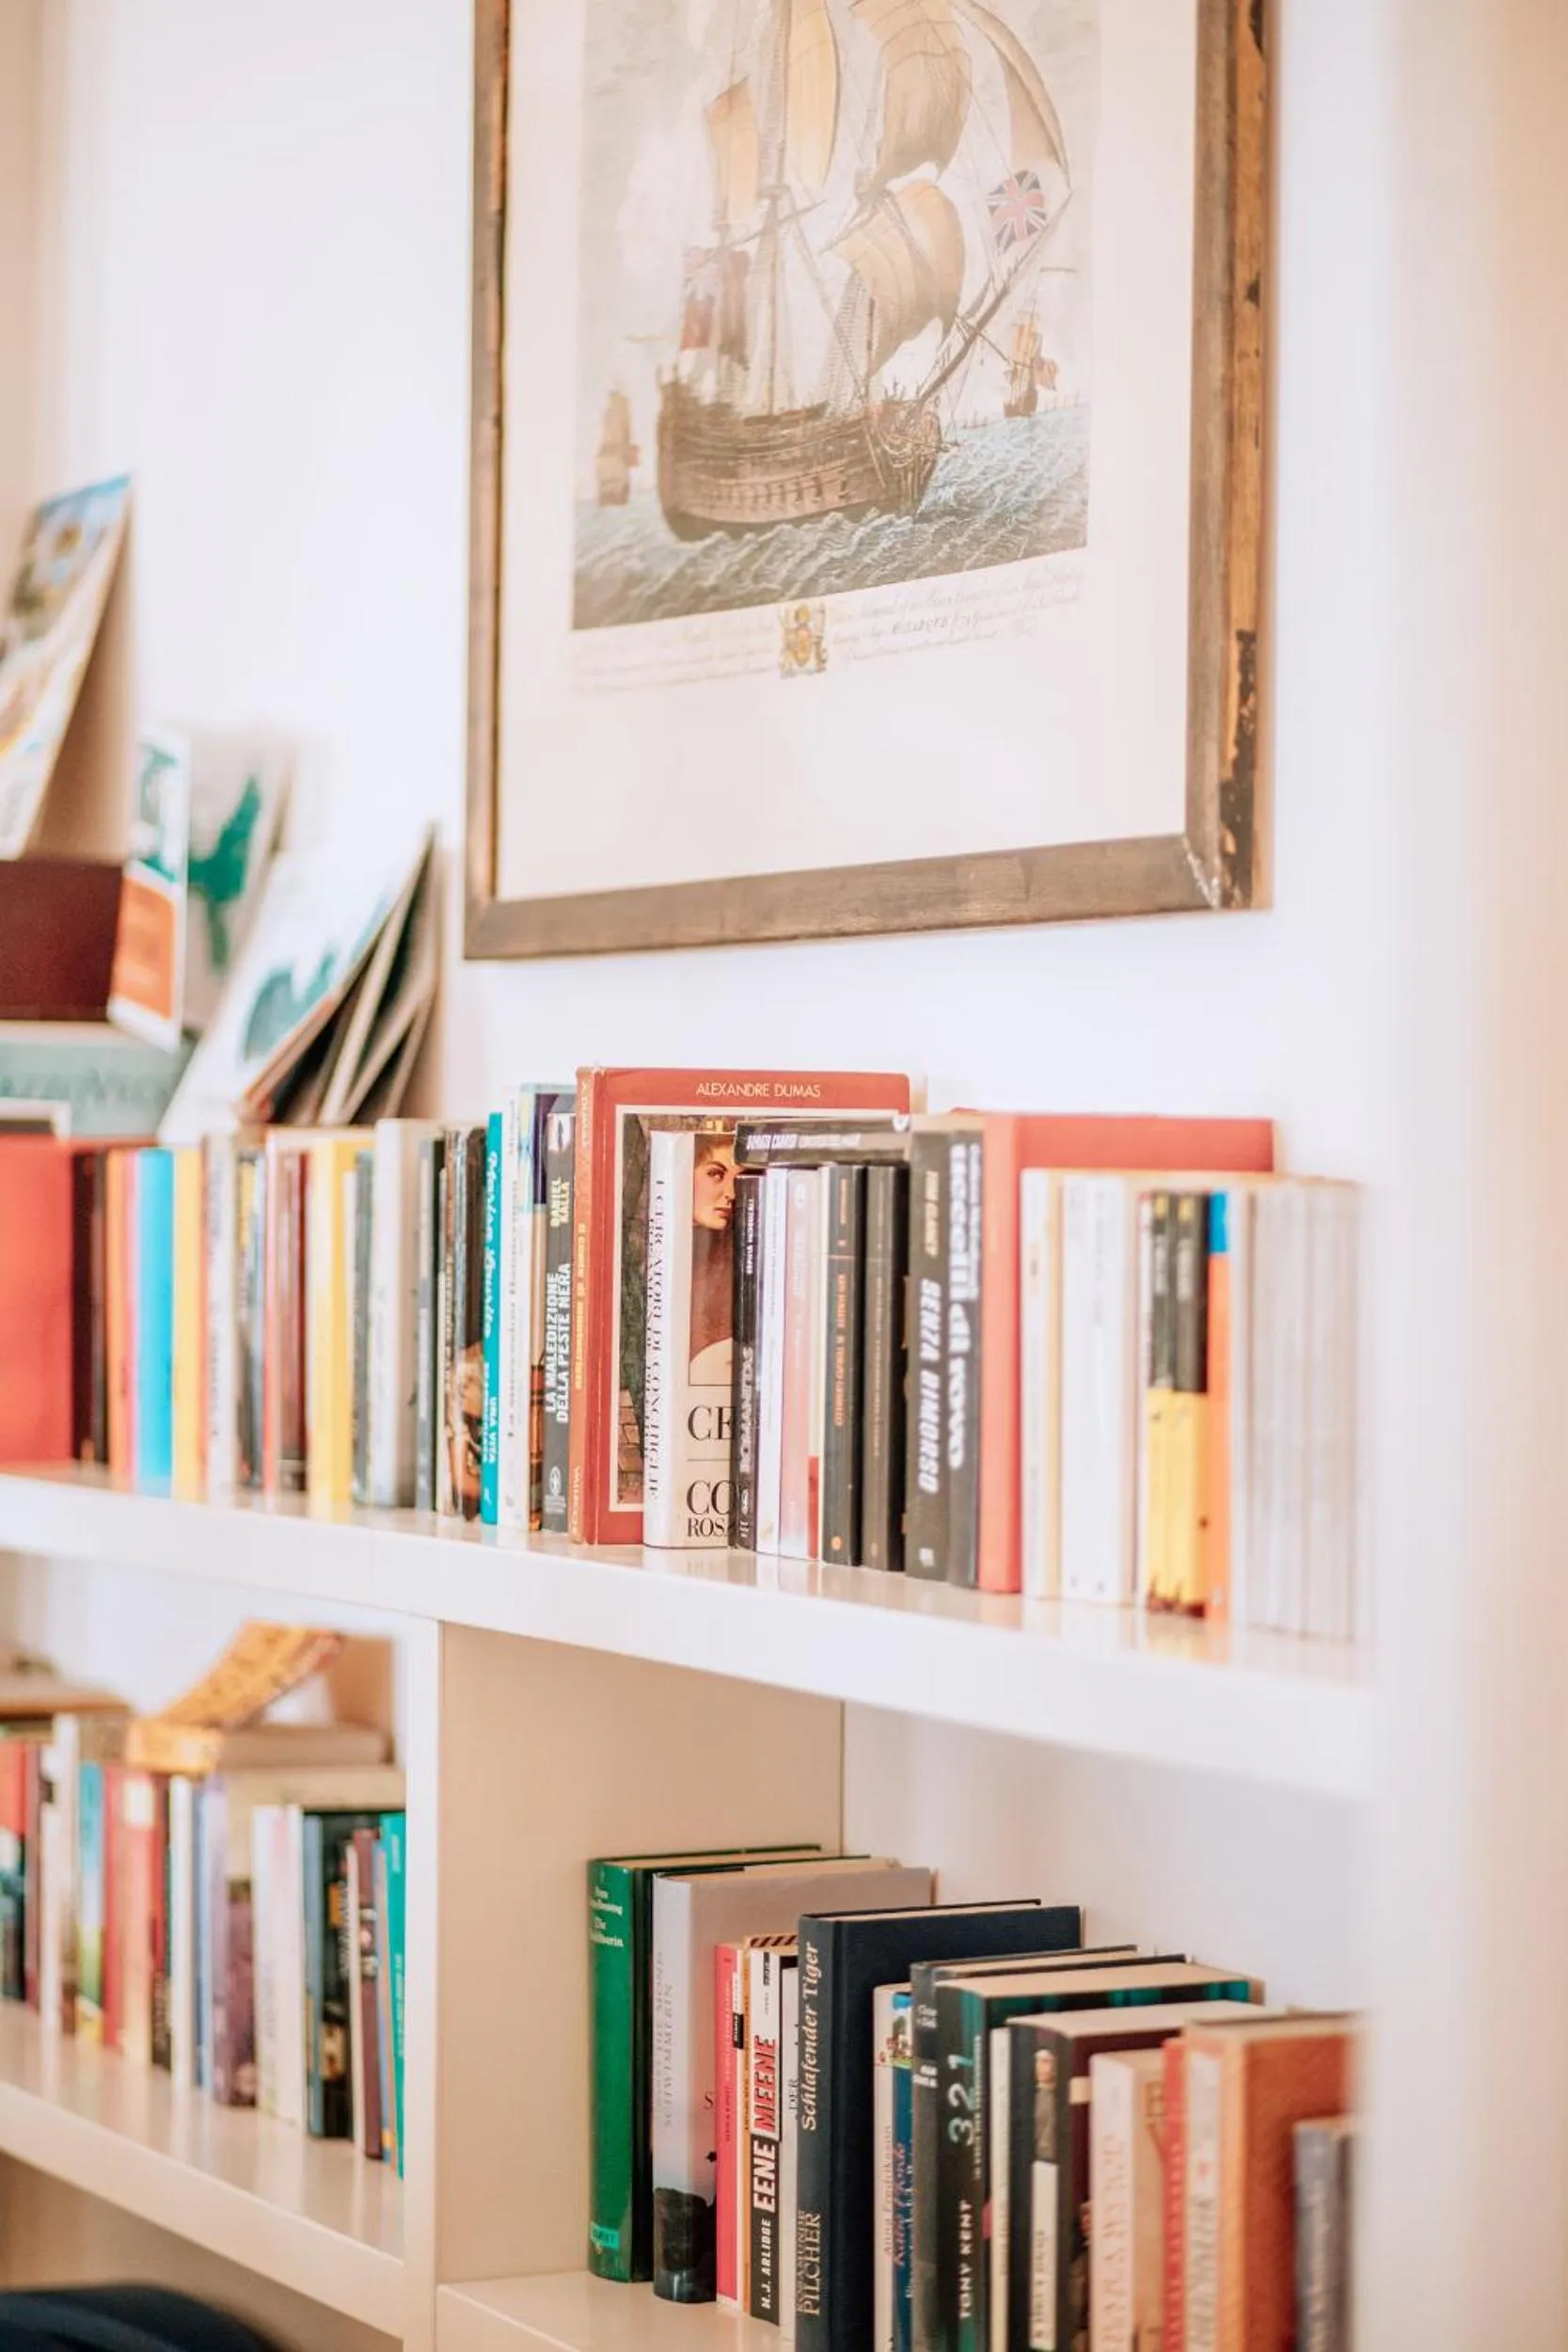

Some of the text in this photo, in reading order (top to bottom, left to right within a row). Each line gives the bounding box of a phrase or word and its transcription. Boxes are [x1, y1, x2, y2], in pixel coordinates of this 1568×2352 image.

[696, 1082, 821, 1099] ALEXANDRE DUMAS
[550, 1177, 562, 1228] DANIEL
[546, 1272, 559, 1413] LA MALEDIZIONE
[557, 1263, 571, 1423] DELLA PESTE NERA
[918, 1279, 942, 1494] SENZA RIMORSO
[739, 1346, 752, 1473] ROMANITAS
[800, 1942, 822, 2132] Schlafender Tiger
[752, 2035, 776, 2214] EENE MEENE
[946, 2054, 974, 2147] 3 2 1
[761, 2219, 771, 2310] M.J. ARLIDGE
[804, 2214, 820, 2316] PILCHER
[959, 2201, 972, 2320] TONY KENT
